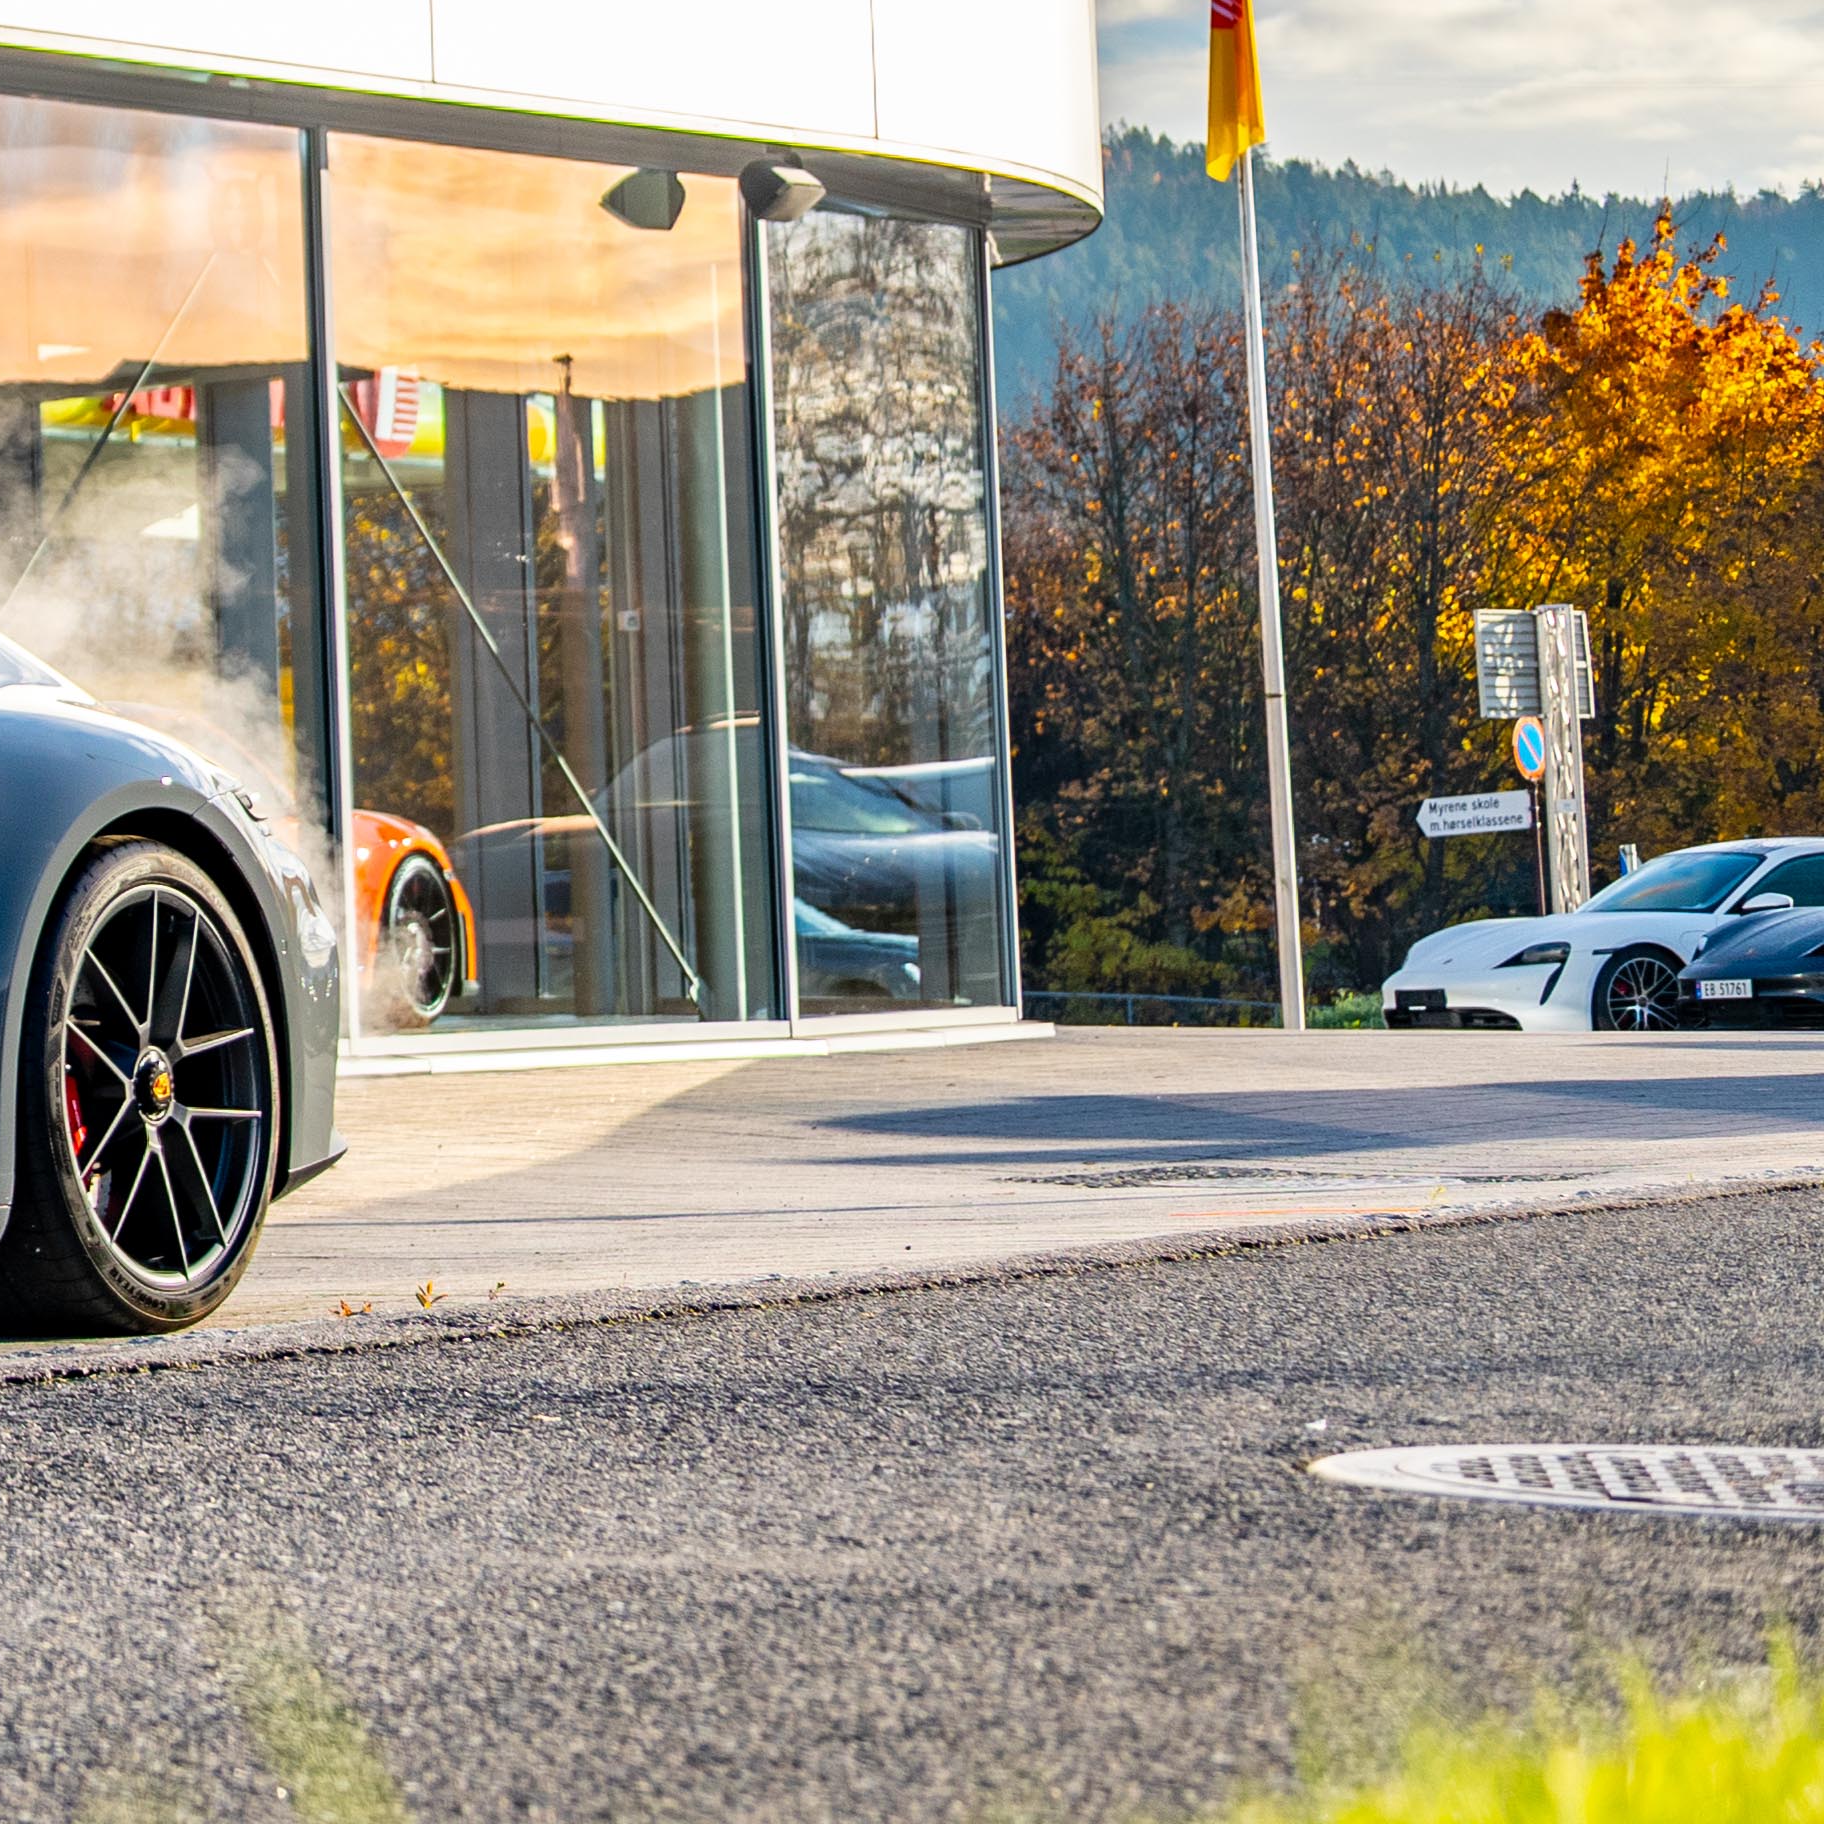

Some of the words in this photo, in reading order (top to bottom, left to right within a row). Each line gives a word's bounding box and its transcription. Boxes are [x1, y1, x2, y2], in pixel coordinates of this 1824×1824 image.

[1429, 801, 1467, 817] Myrene
[1472, 796, 1499, 811] skole
[1719, 982, 1747, 996] 51761
